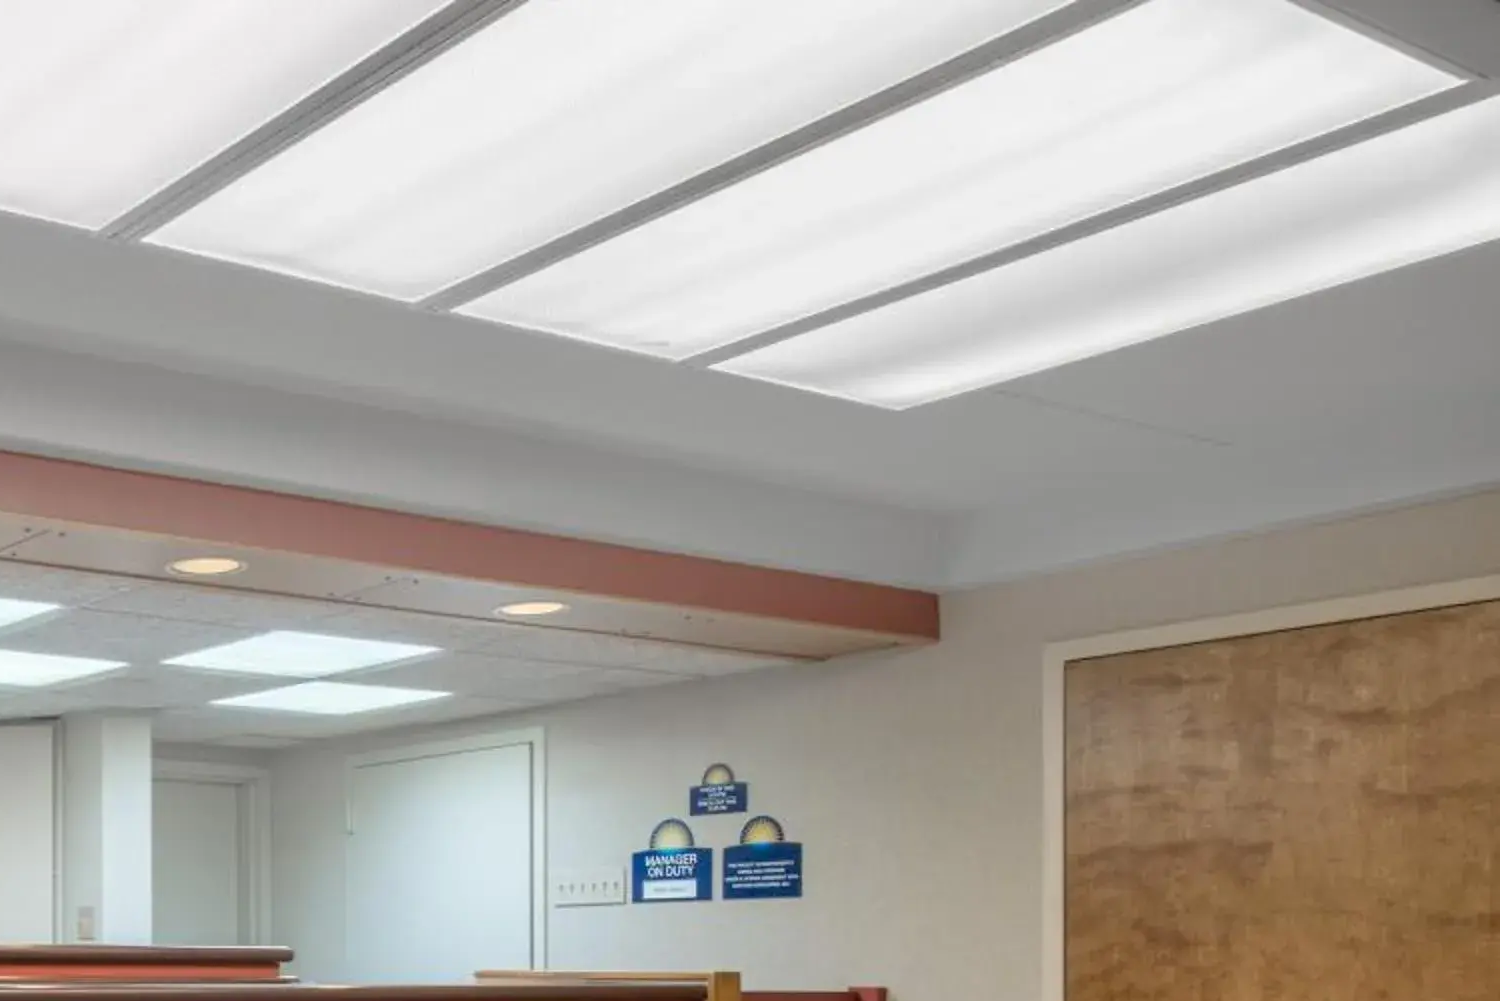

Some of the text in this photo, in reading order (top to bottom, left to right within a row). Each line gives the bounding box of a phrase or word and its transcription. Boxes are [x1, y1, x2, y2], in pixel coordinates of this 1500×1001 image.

[645, 853, 697, 866] MANAGER
[647, 865, 694, 878] ON DUTY
